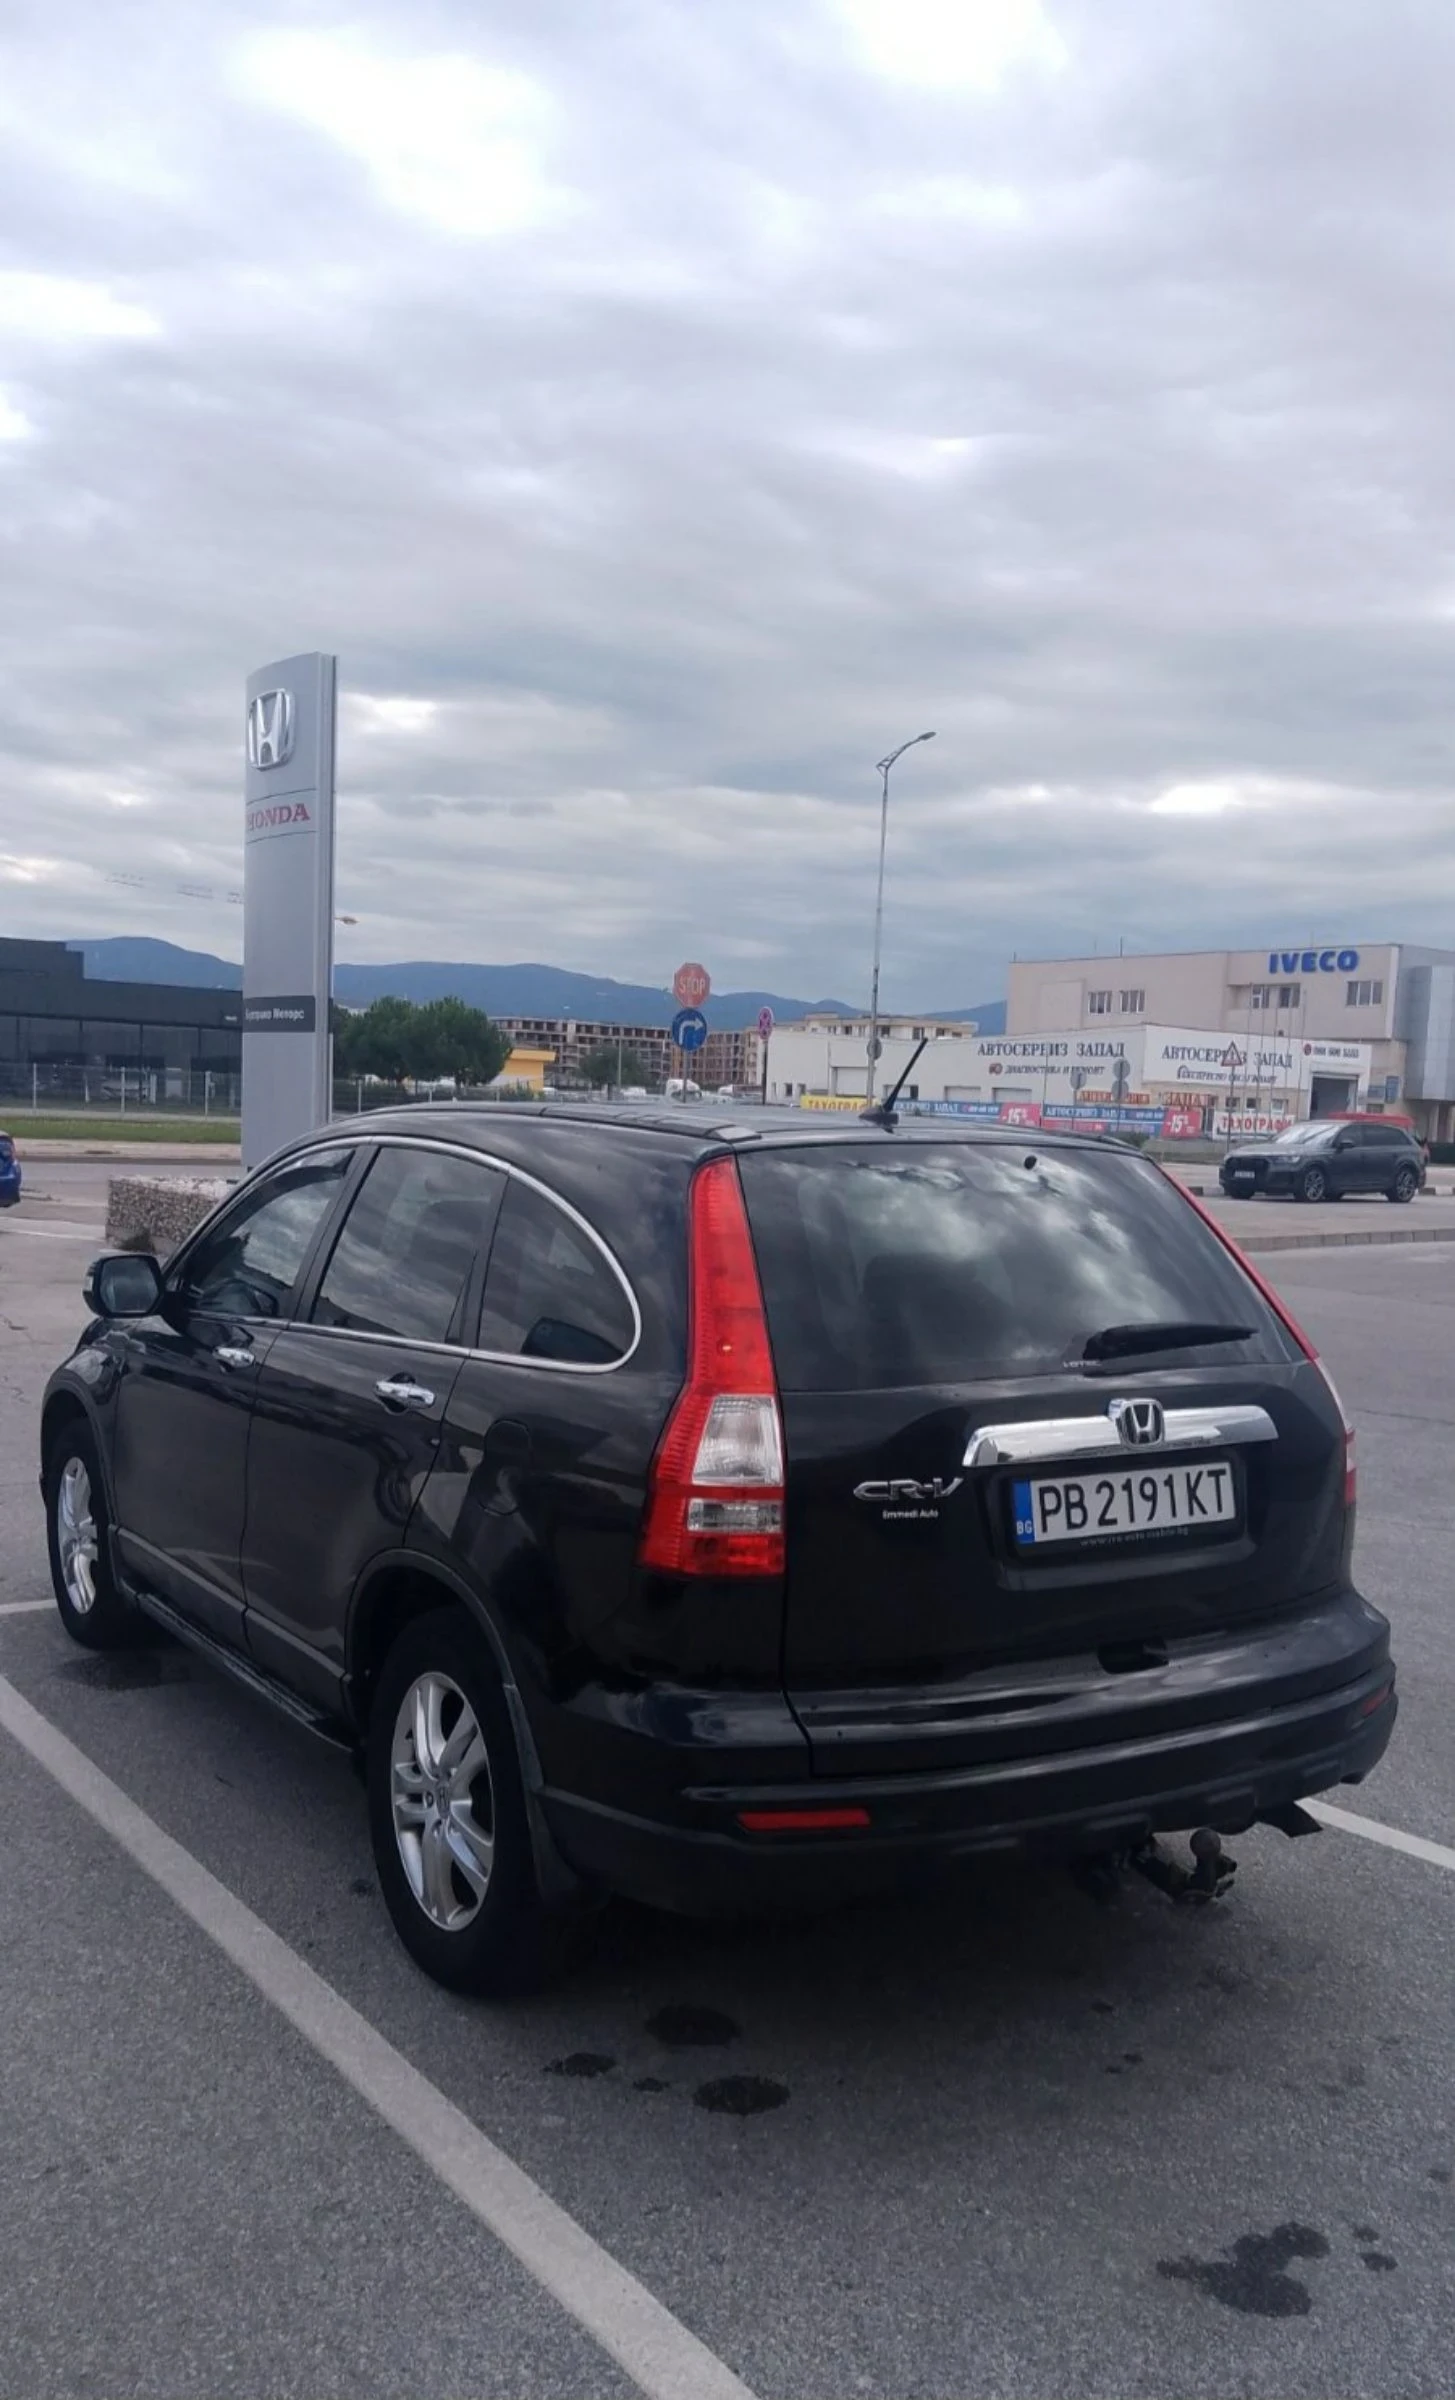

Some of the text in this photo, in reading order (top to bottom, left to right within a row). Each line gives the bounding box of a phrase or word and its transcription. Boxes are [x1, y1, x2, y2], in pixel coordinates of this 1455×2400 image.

[248, 802, 310, 832] HONDA
[1268, 950, 1359, 974] IVECO
[678, 974, 706, 994] STOP
[1076, 1042, 1125, 1058] ЗАПАД
[1253, 1051, 1293, 1069] ЗАПАД
[853, 1477, 964, 1501] CR-V
[1015, 1519, 1033, 1536] BG
